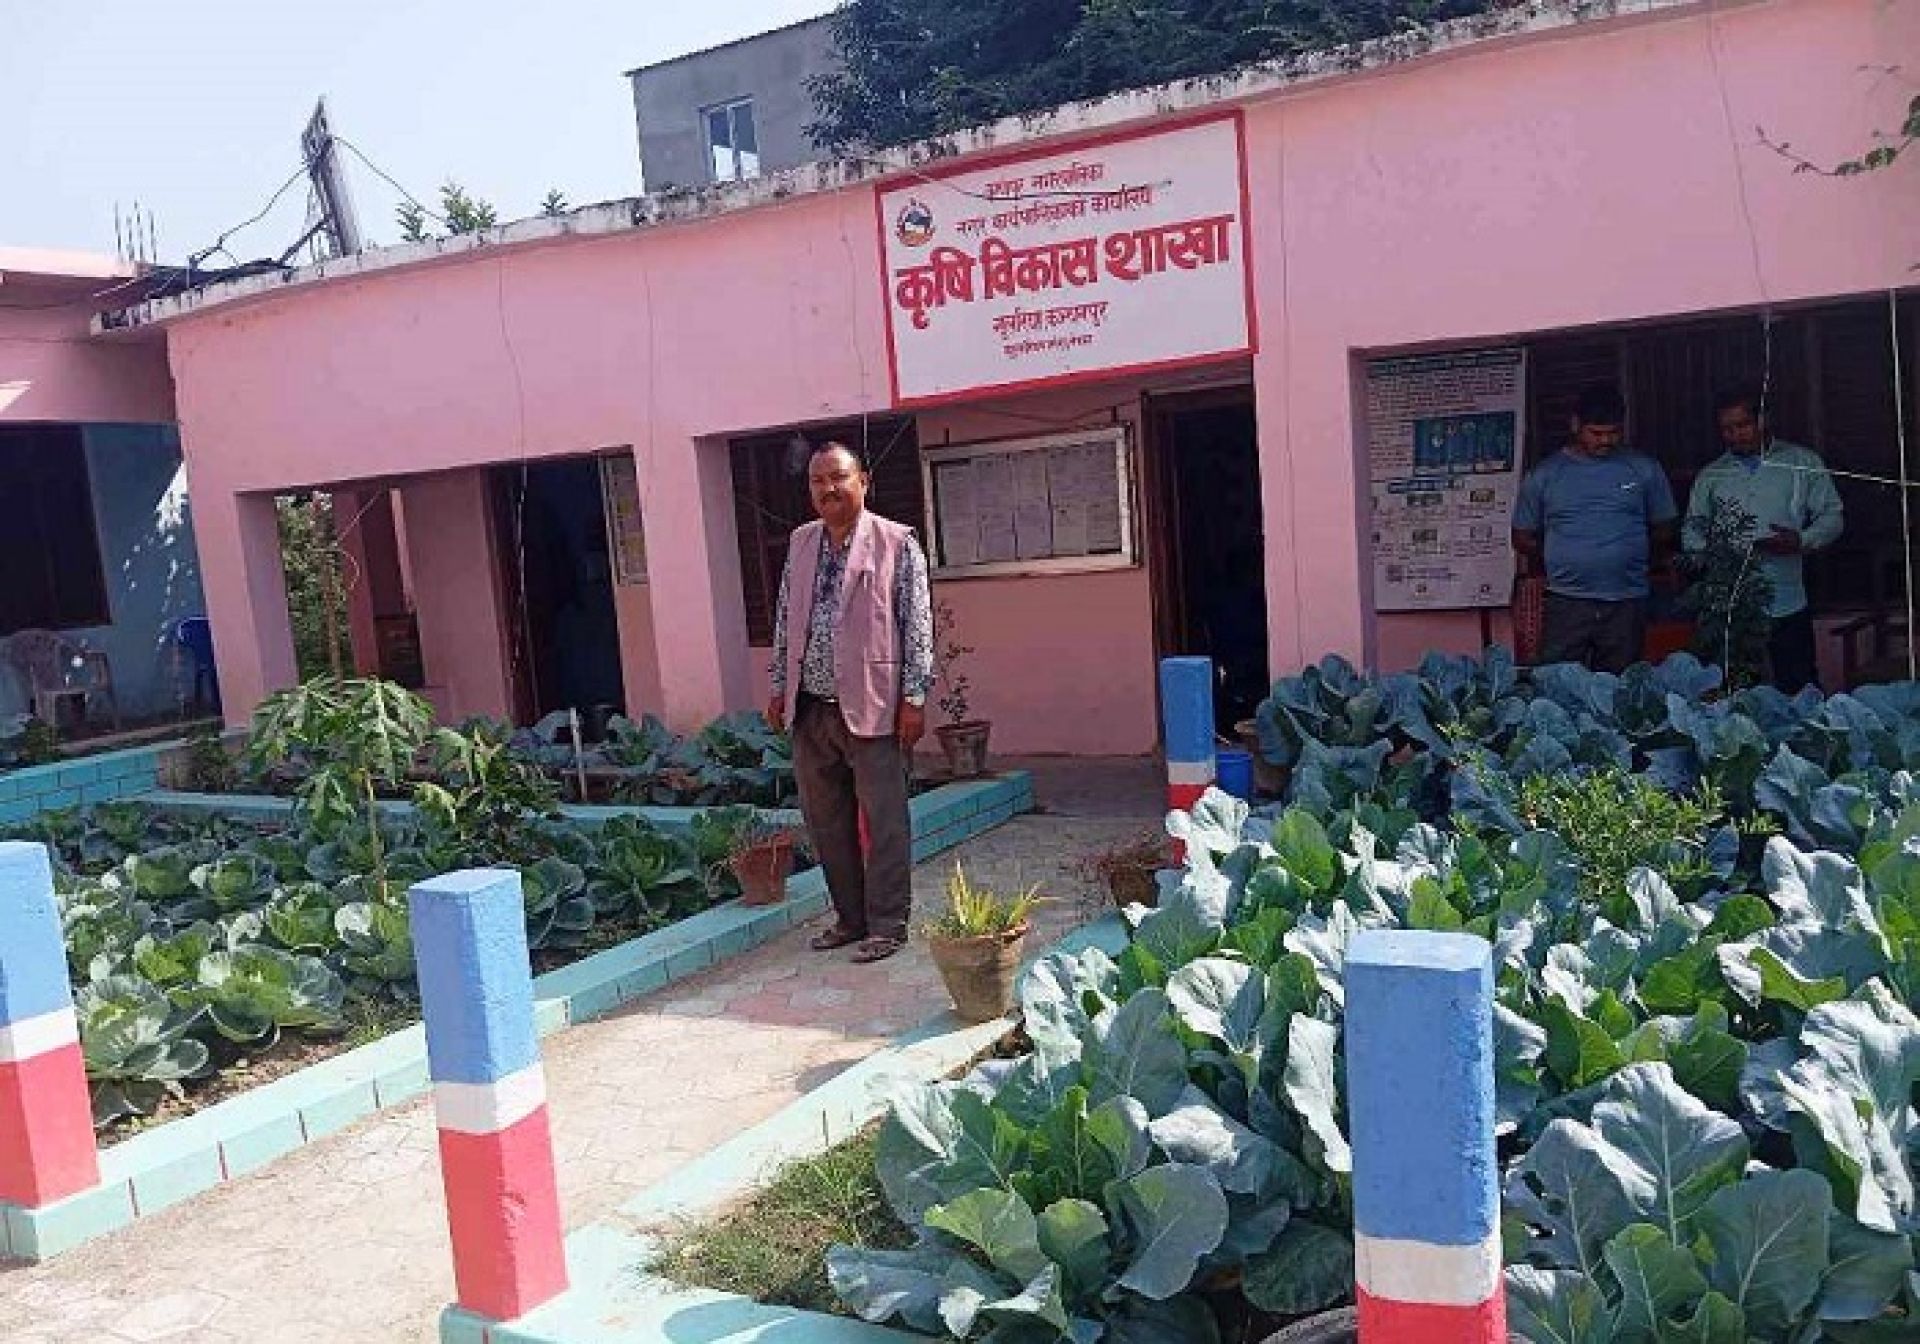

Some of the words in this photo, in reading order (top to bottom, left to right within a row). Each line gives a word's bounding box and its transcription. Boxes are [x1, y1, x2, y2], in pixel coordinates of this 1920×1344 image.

[896, 246, 976, 329] कृषि
[981, 236, 1098, 299] विकास
[1104, 213, 1235, 280] शाखा
